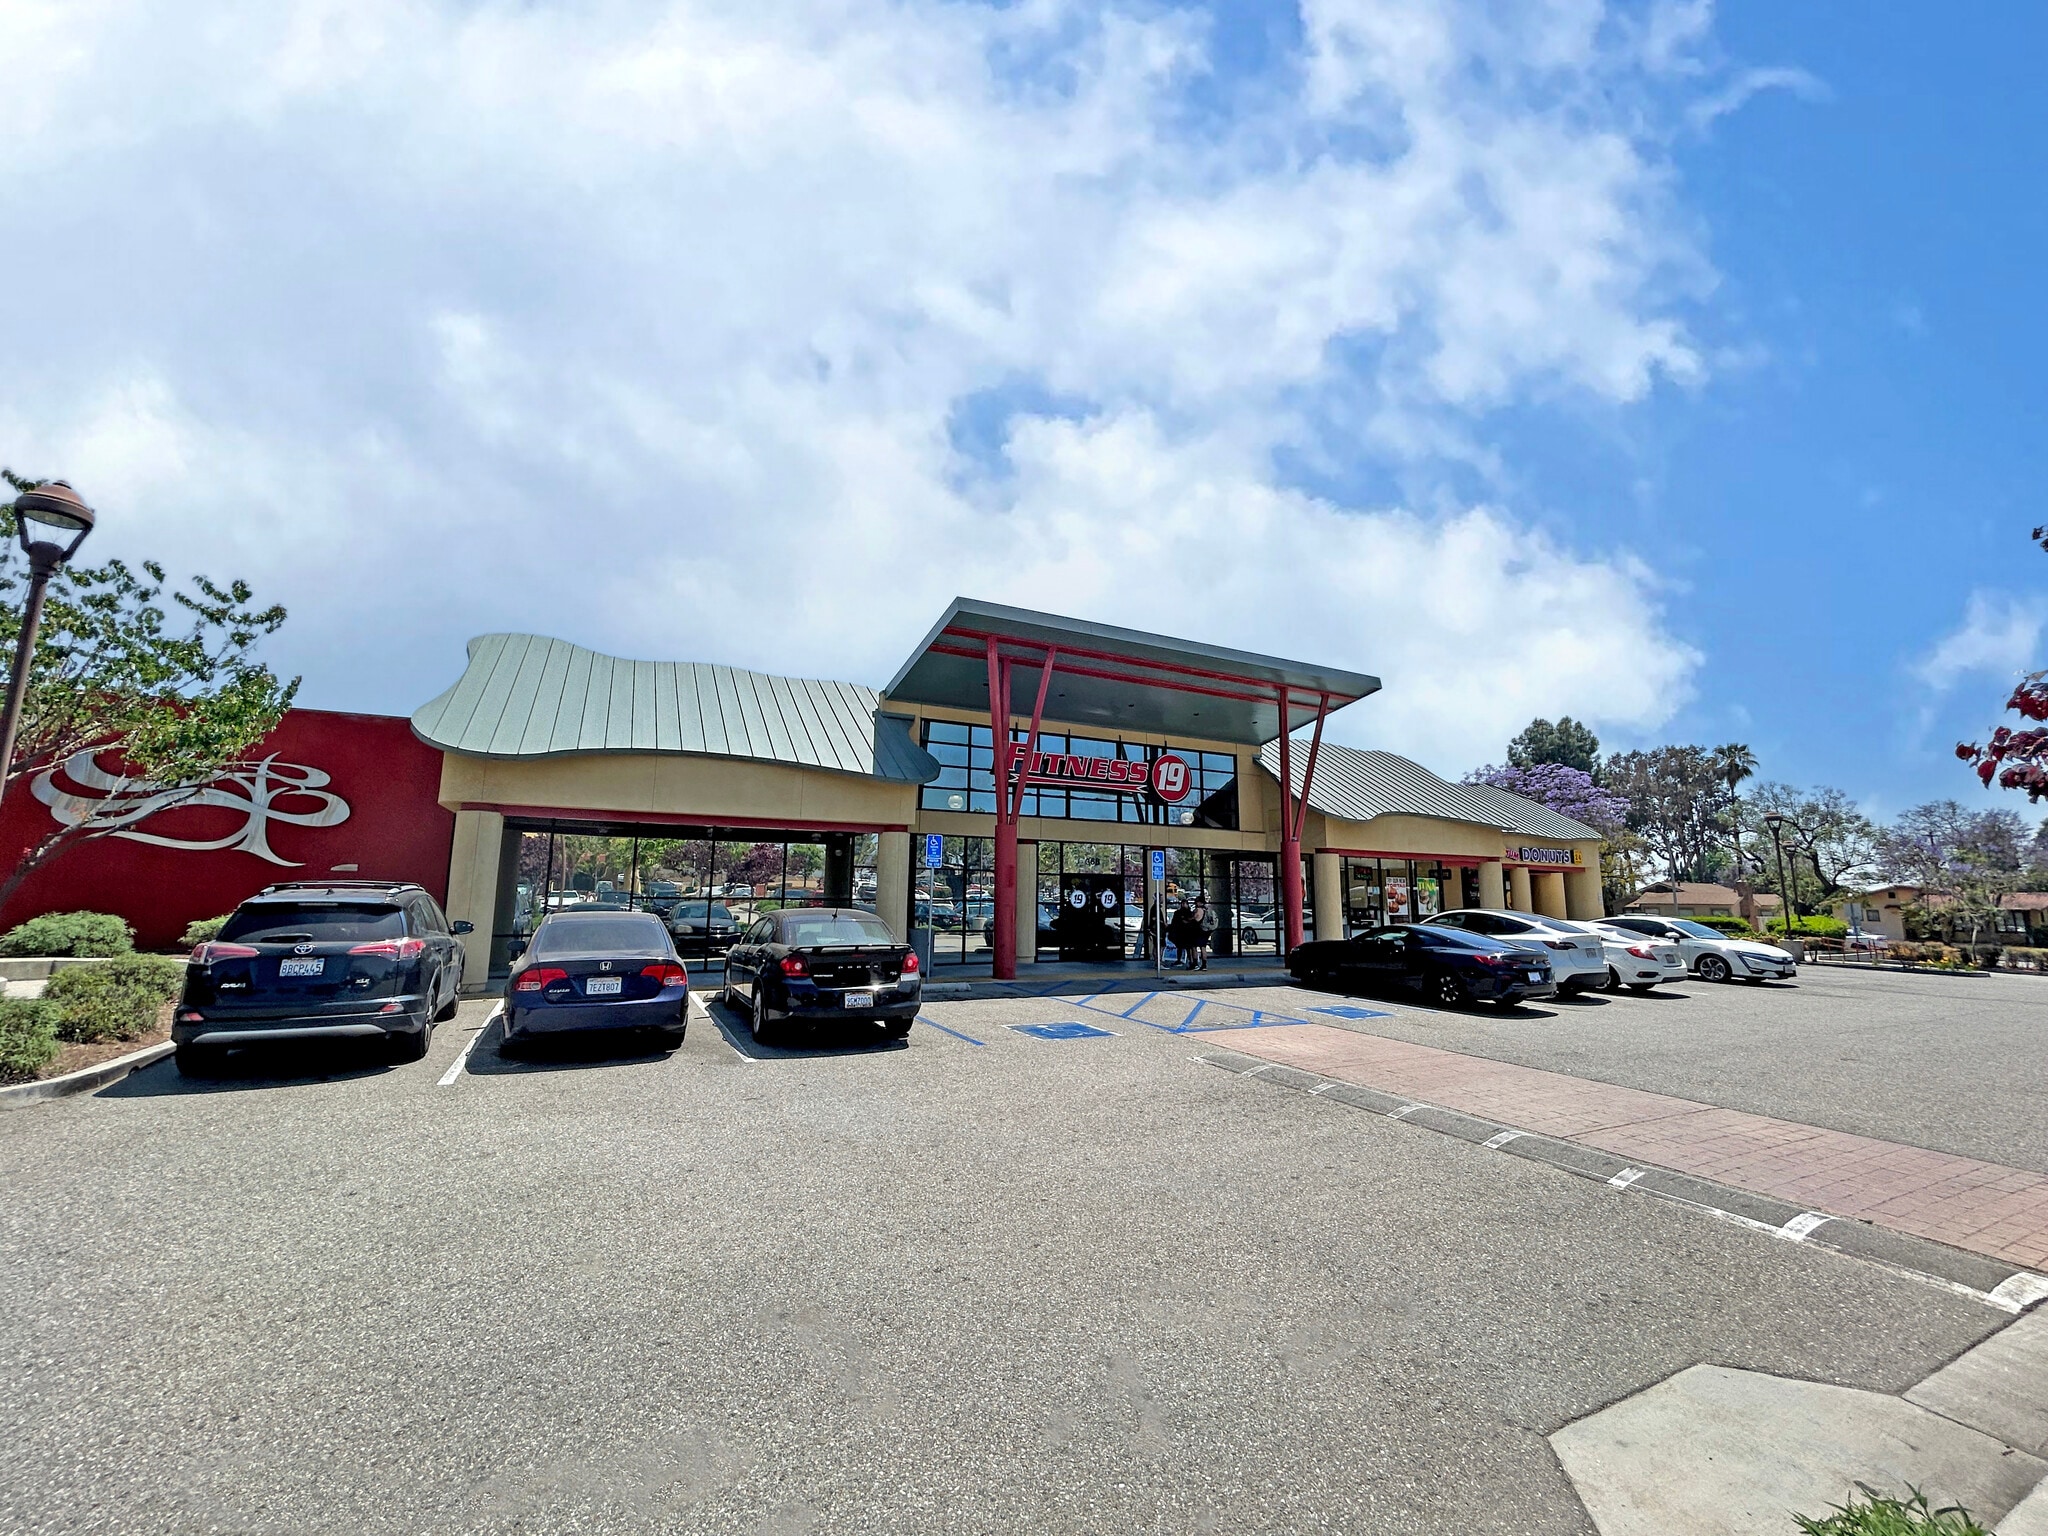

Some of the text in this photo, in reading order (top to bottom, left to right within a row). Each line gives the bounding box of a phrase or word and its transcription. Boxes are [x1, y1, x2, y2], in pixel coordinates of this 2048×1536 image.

[1008, 741, 1185, 792] FITNESS 19
[1522, 847, 1571, 864] DONUTS
[1073, 894, 1083, 904] 19
[1104, 894, 1113, 904] 19
[281, 963, 321, 975] 8BCP445
